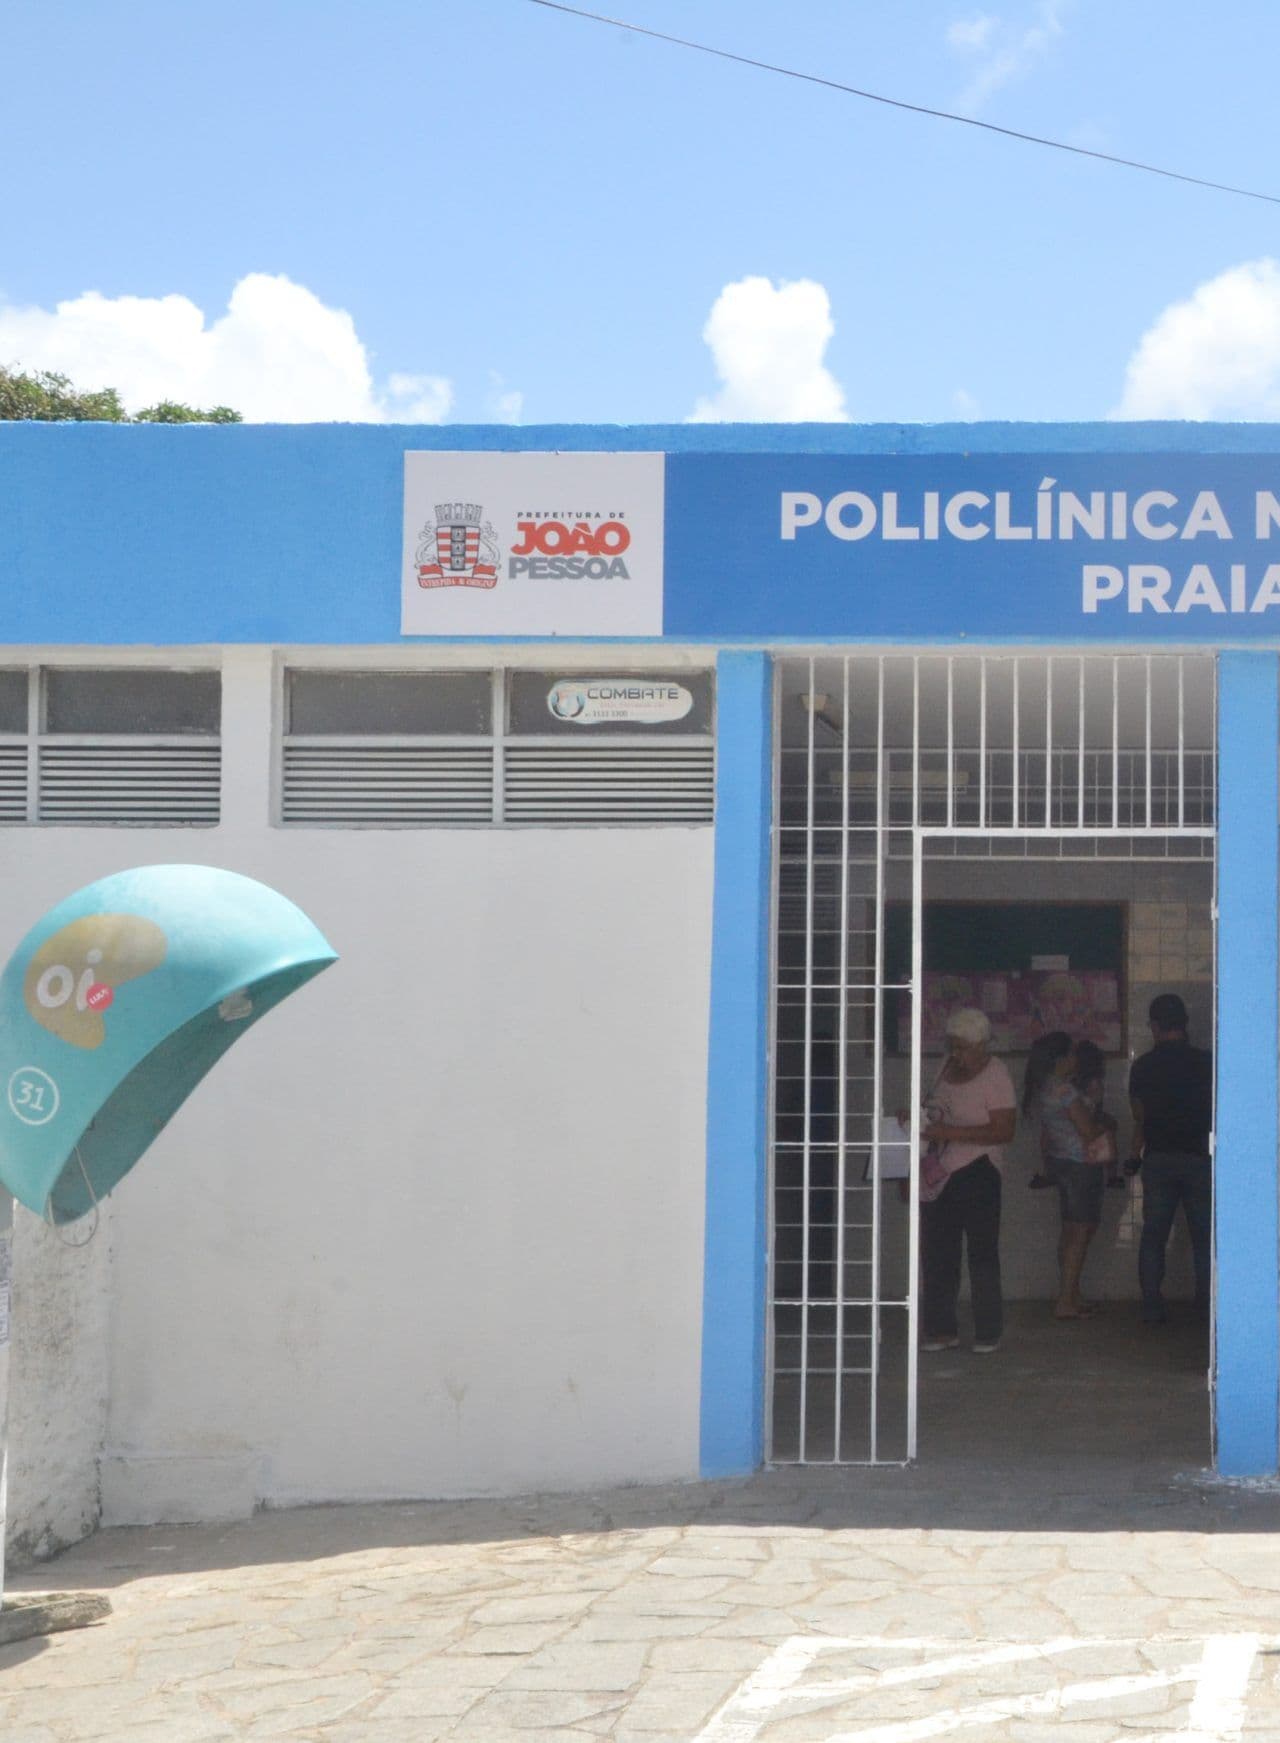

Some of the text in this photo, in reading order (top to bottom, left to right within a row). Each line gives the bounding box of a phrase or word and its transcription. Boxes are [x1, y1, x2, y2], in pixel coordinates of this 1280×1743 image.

[517, 511, 625, 519] PREFEITURA DE
[780, 477, 1233, 541] POLICLÍNICA
[510, 521, 631, 556] JOÃO
[508, 556, 631, 580] PESSOA
[587, 687, 679, 700] COMBATE
[16, 1079, 45, 1111] 31
